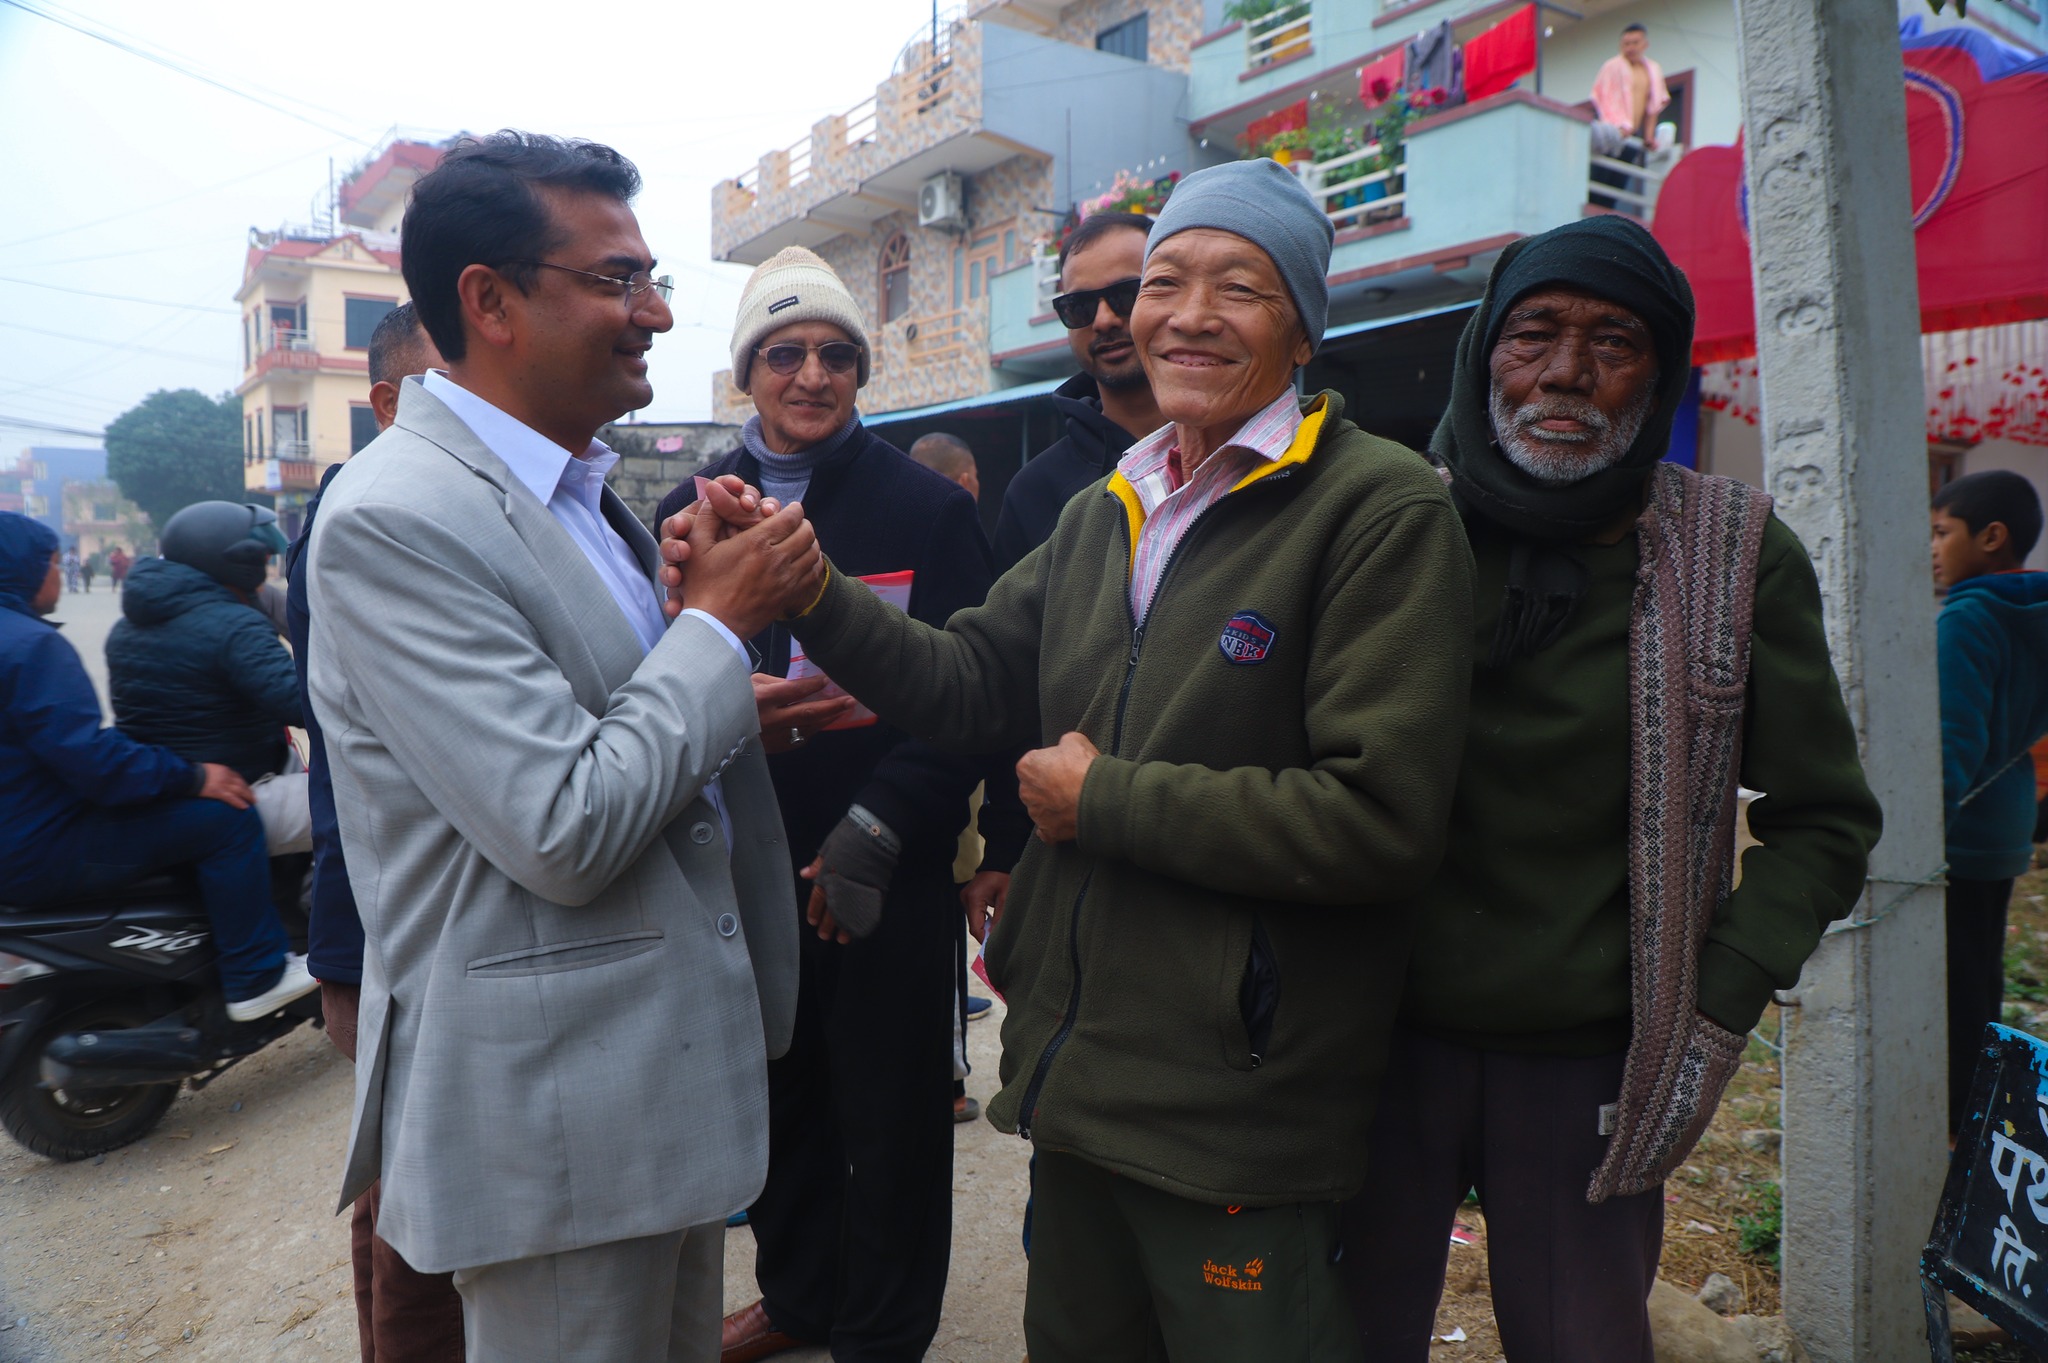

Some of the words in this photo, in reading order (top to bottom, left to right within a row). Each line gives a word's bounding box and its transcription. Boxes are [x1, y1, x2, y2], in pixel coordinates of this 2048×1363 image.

[1231, 629, 1257, 644] KIDS
[1222, 635, 1260, 658] NBK
[1203, 1259, 1238, 1277] Jack
[1203, 1271, 1263, 1291] Wolfskin
